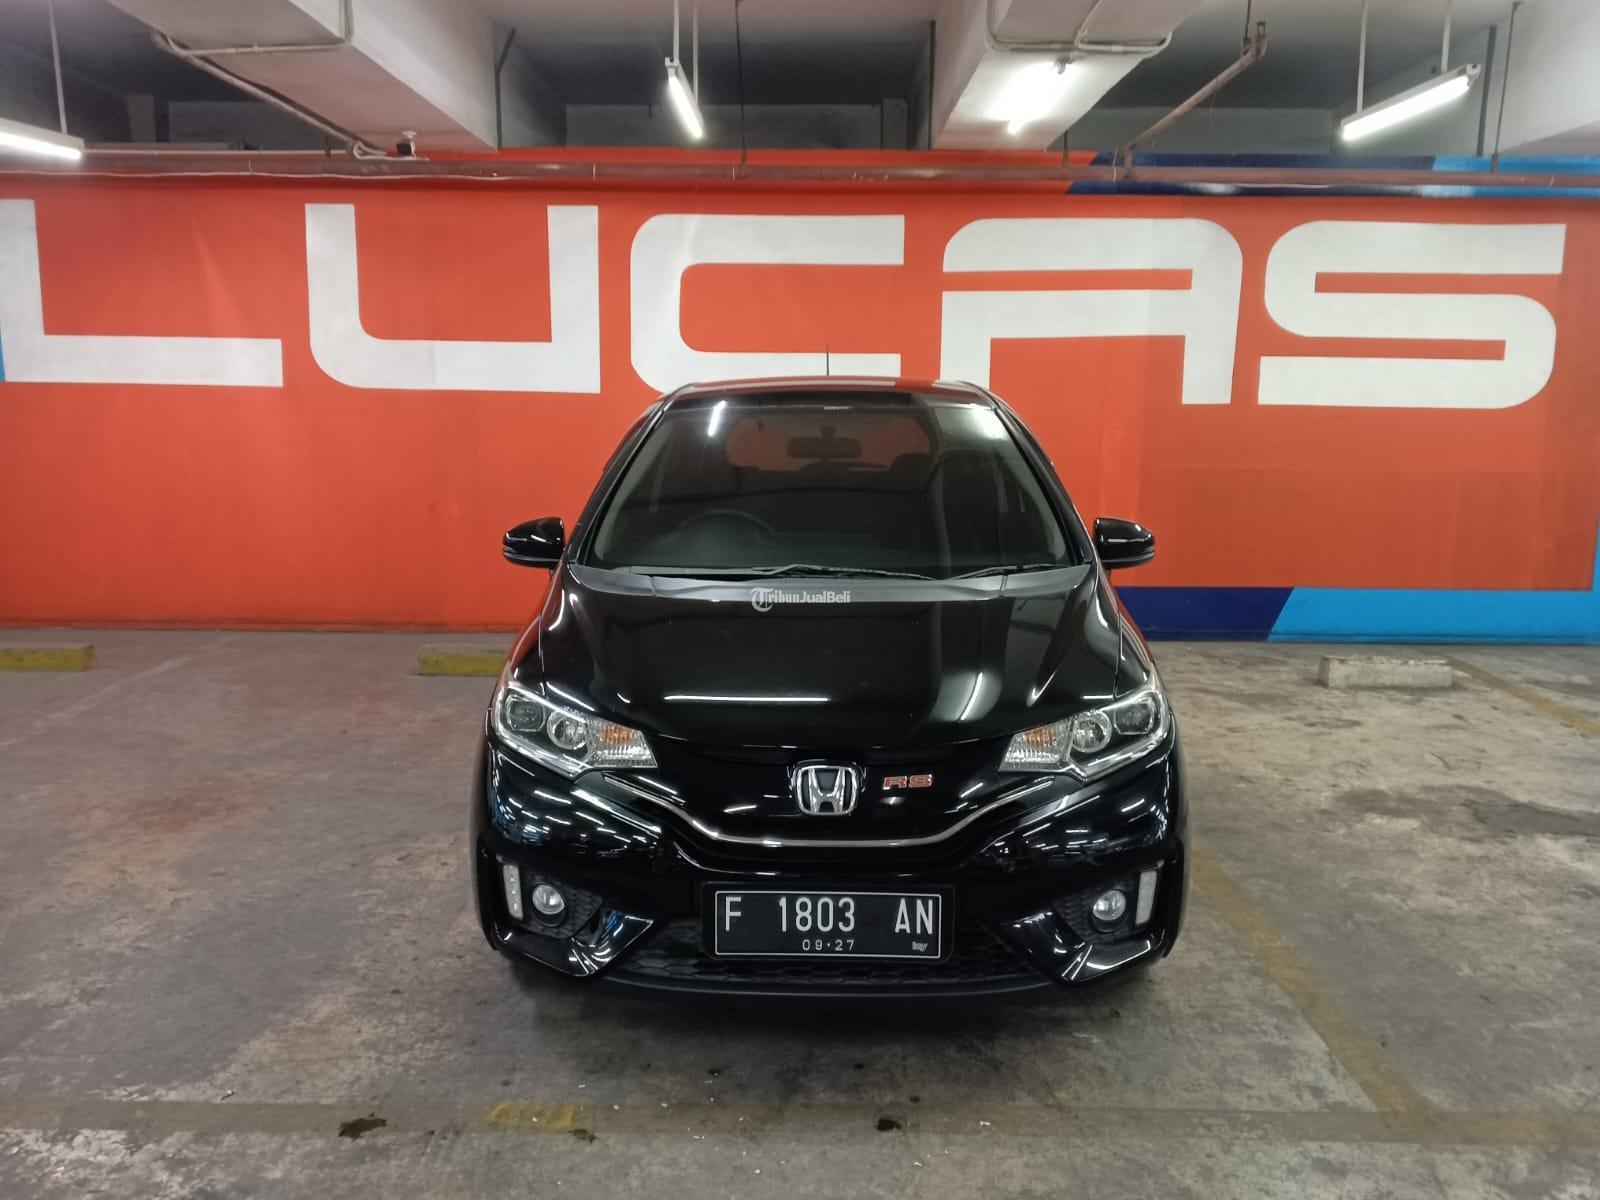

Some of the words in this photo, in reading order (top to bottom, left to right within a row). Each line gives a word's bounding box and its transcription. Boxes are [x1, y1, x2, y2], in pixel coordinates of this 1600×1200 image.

[0, 198, 1567, 410] LUCAS
[882, 774, 933, 790] RS
[725, 896, 742, 932] F
[778, 896, 855, 933] 1803
[894, 898, 934, 935] AN
